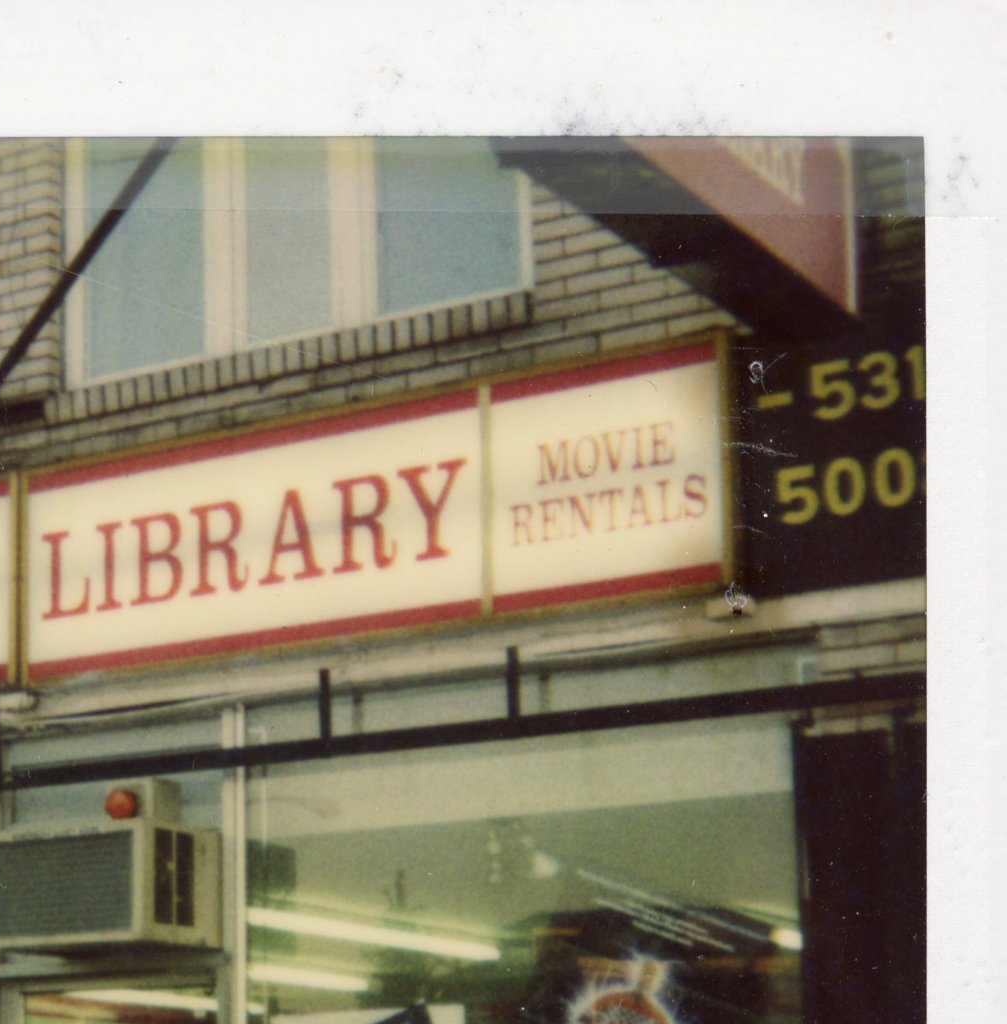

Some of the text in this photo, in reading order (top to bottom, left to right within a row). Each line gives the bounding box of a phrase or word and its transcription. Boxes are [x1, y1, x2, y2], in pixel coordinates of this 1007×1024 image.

[536, 420, 676, 487] MOVIE
[775, 448, 925, 526] 500
[42, 459, 467, 620] LIBRARY
[510, 473, 709, 547] RENTALS
